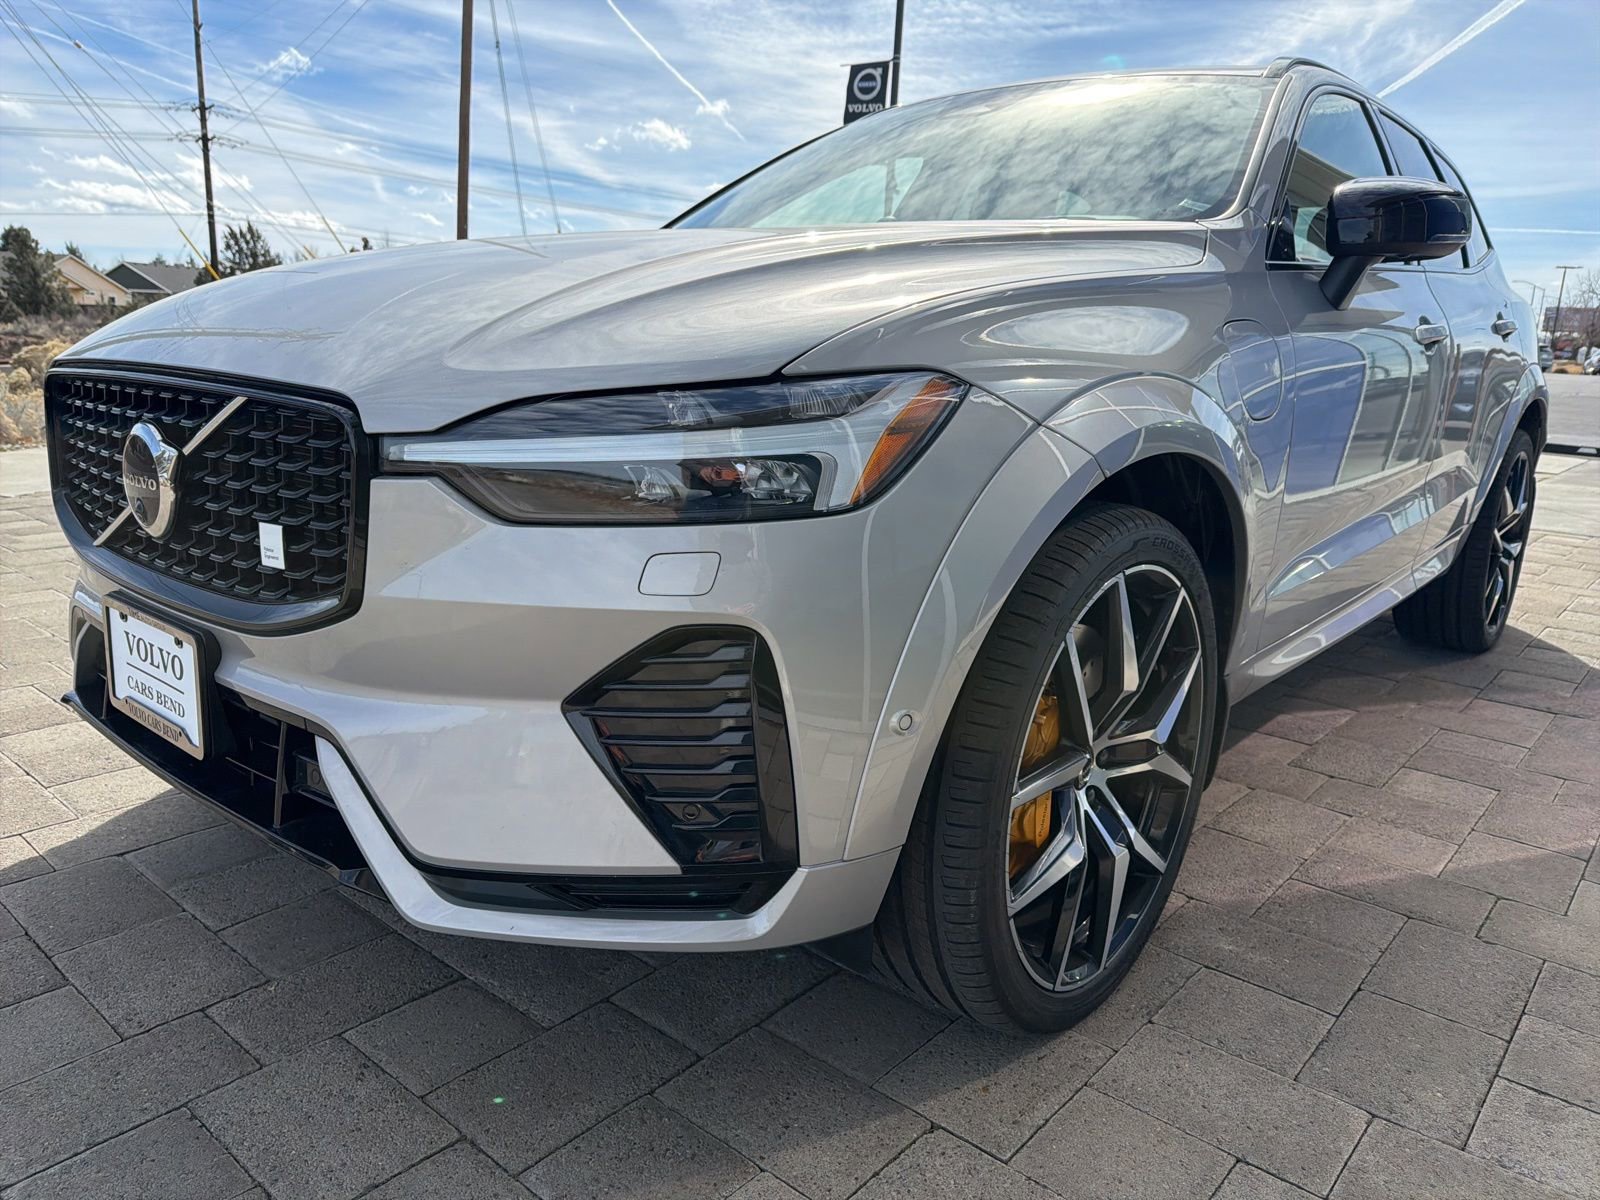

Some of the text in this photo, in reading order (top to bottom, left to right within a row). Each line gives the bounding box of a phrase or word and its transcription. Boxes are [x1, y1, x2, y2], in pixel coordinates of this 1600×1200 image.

[847, 103, 883, 113] VOLVO
[123, 630, 184, 681] VOLVO
[127, 675, 185, 718] CARS BEND
[128, 703, 179, 742] VOLVO CARS BEND
